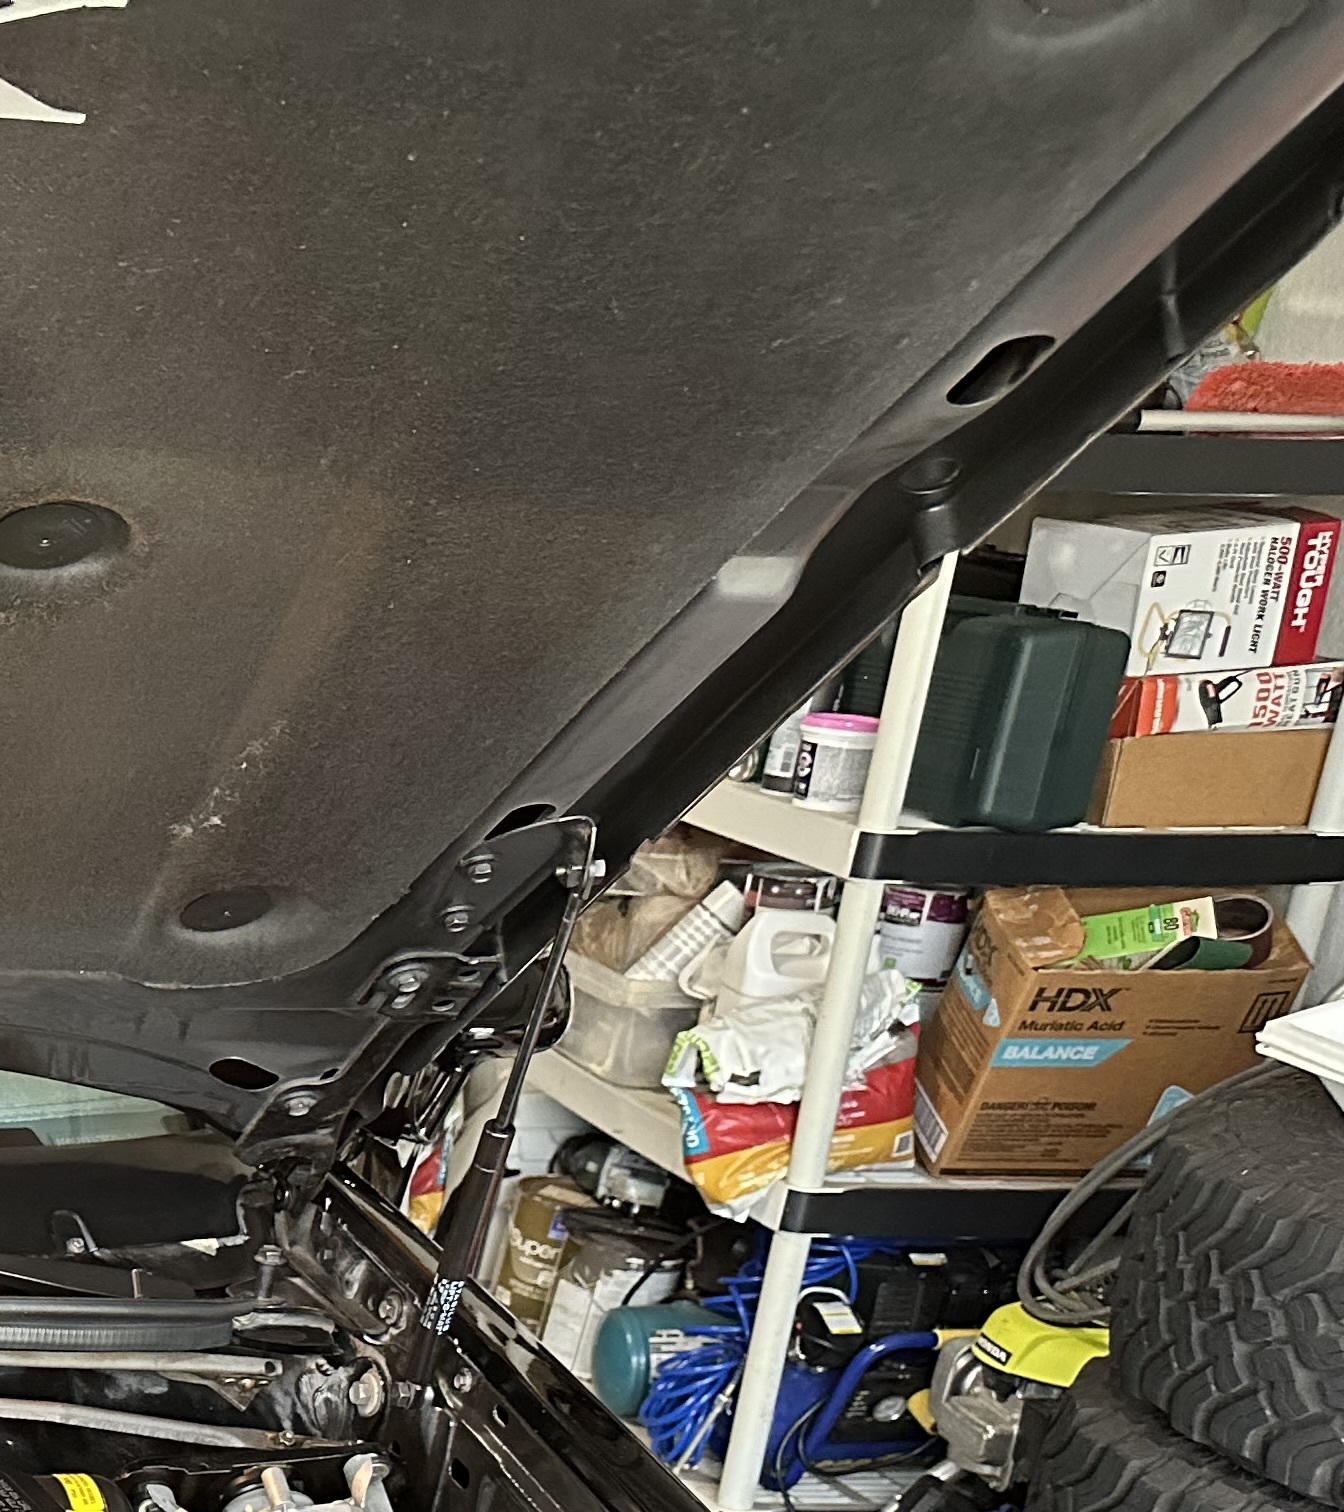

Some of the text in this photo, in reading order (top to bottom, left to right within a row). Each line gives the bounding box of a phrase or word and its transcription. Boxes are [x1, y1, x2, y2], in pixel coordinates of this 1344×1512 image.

[1248, 537, 1280, 653] HALOGEN WORK LIGHT
[1269, 536, 1292, 602] 500-WATT
[1291, 534, 1320, 628] TOUGH
[1248, 671, 1272, 727] 1500
[1262, 672, 1287, 728] WATT
[1018, 1019, 1125, 1033] Muriatic Acid
[1028, 987, 1121, 1013] HDX
[1002, 1045, 1100, 1061] BALANCE
